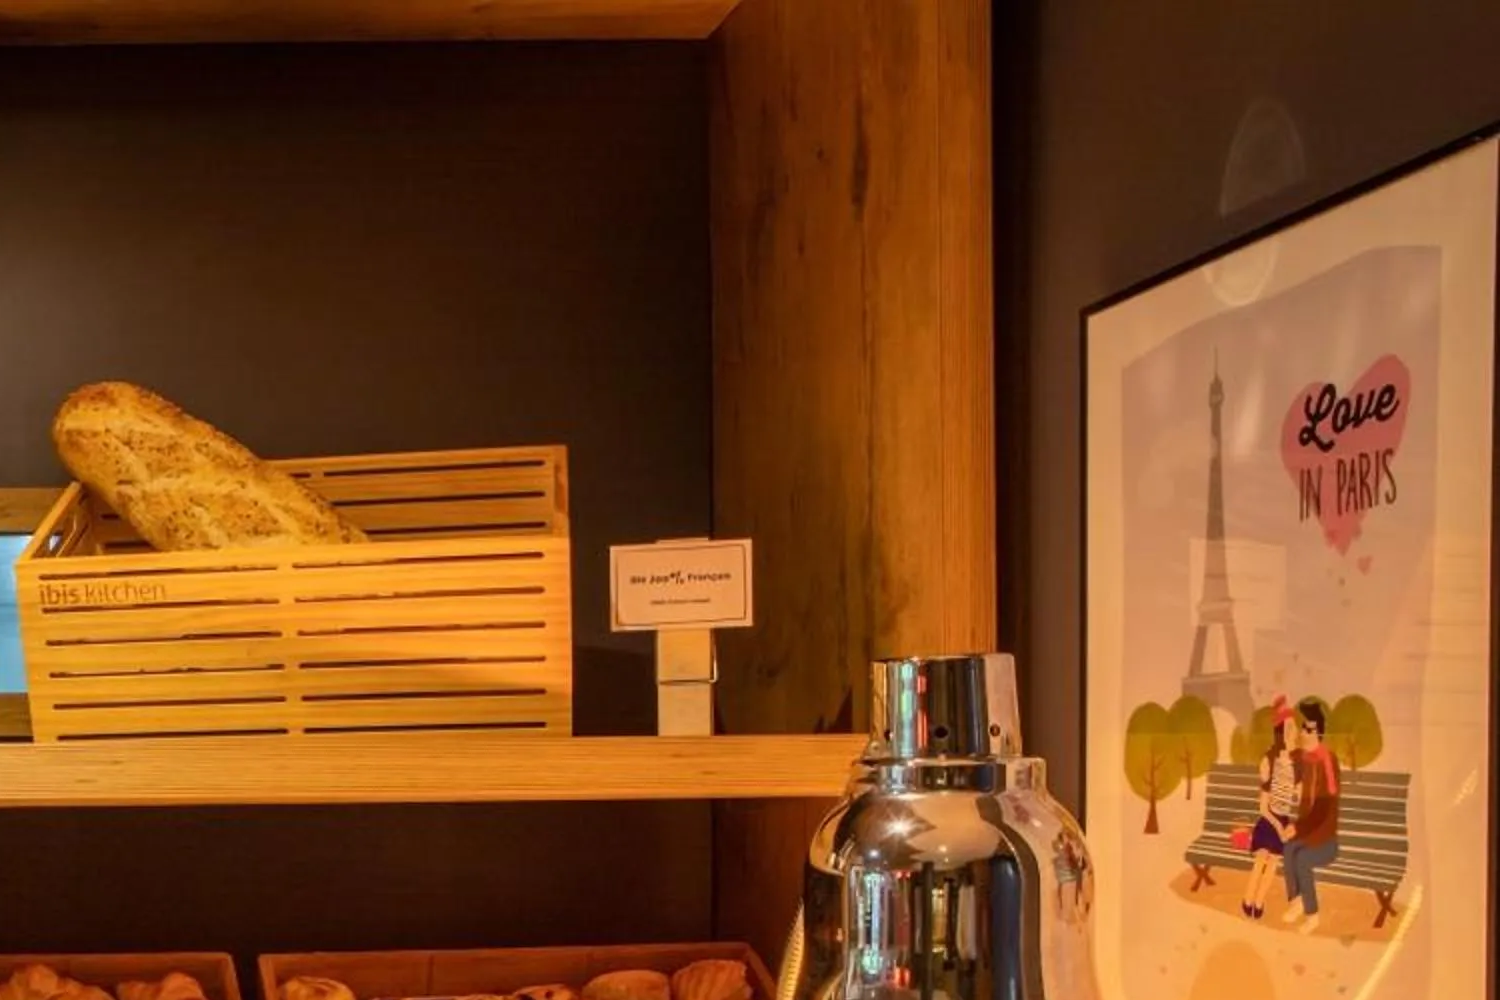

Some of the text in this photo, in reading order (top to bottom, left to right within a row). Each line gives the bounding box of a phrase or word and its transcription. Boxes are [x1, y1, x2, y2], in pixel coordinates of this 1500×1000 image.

[1298, 383, 1400, 452] Love
[1299, 448, 1397, 522] IN PARIS
[39, 581, 167, 605] ibis kitchen
